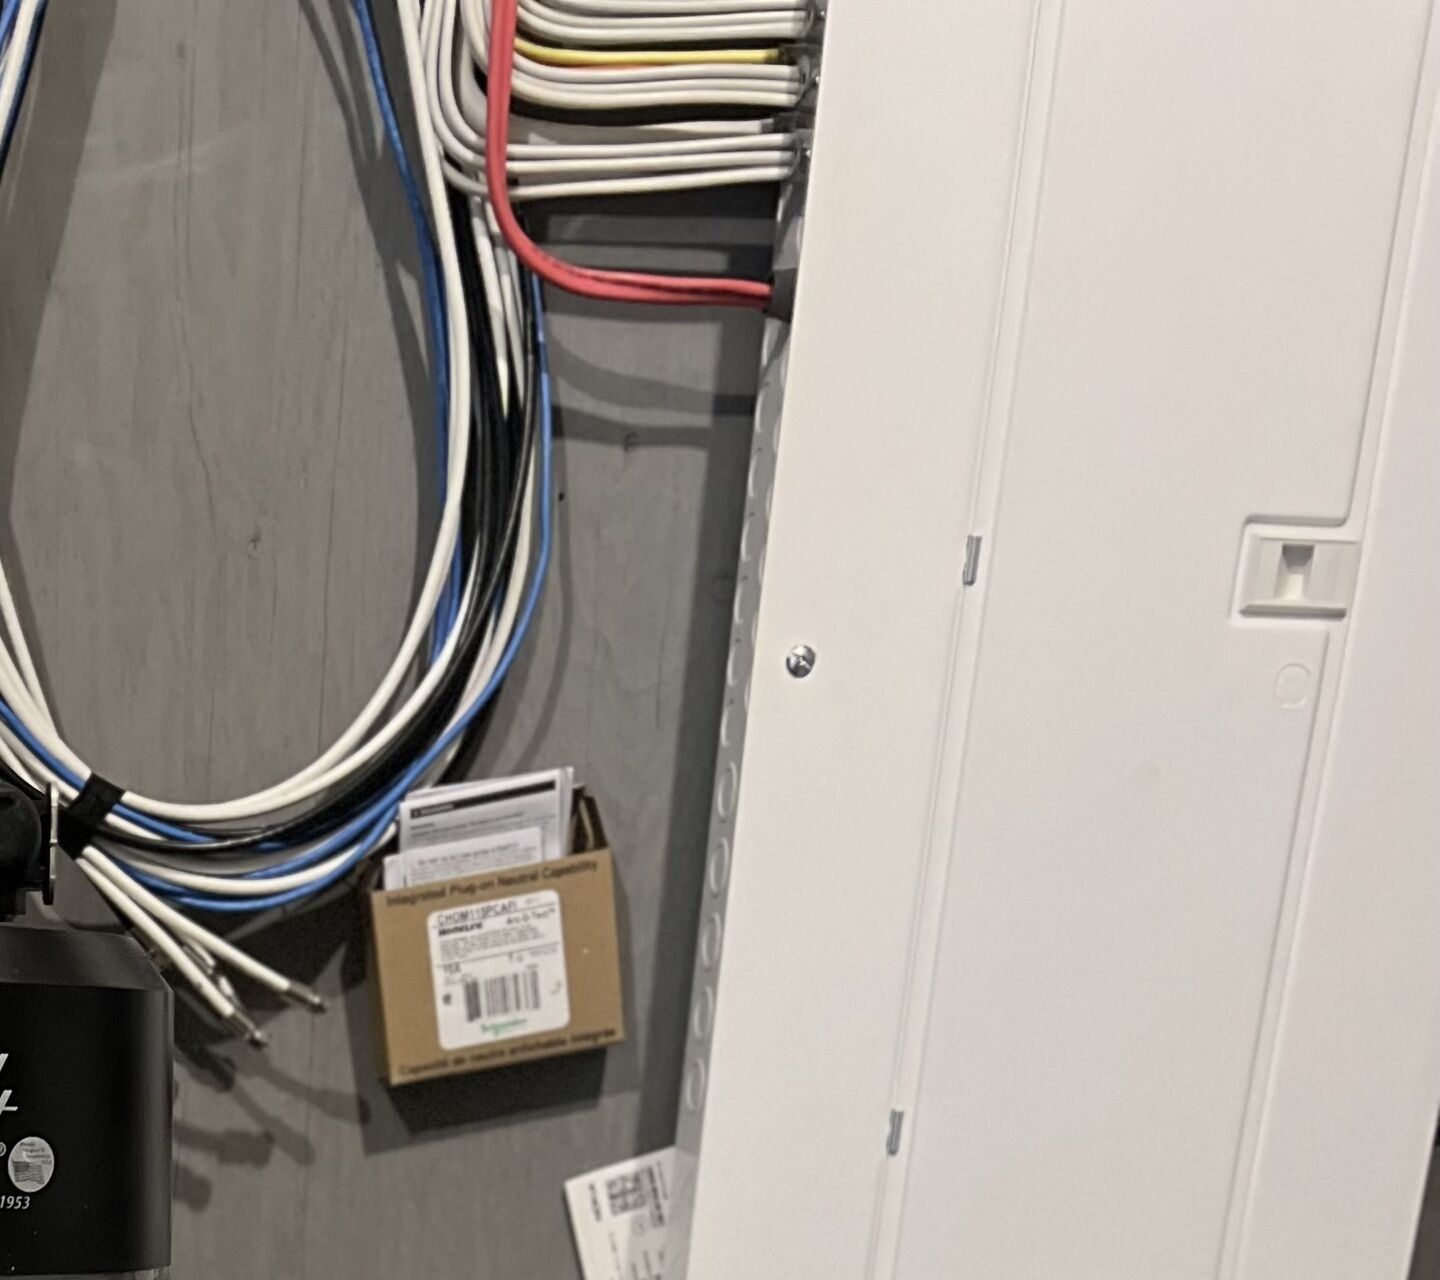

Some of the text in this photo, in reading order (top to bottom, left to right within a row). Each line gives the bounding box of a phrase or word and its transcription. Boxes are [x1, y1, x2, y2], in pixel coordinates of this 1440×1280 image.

[449, 880, 495, 896] Plug-on
[497, 870, 539, 887] Neutral
[542, 860, 598, 879] Capability
[0, 1195, 31, 1211] 1953
